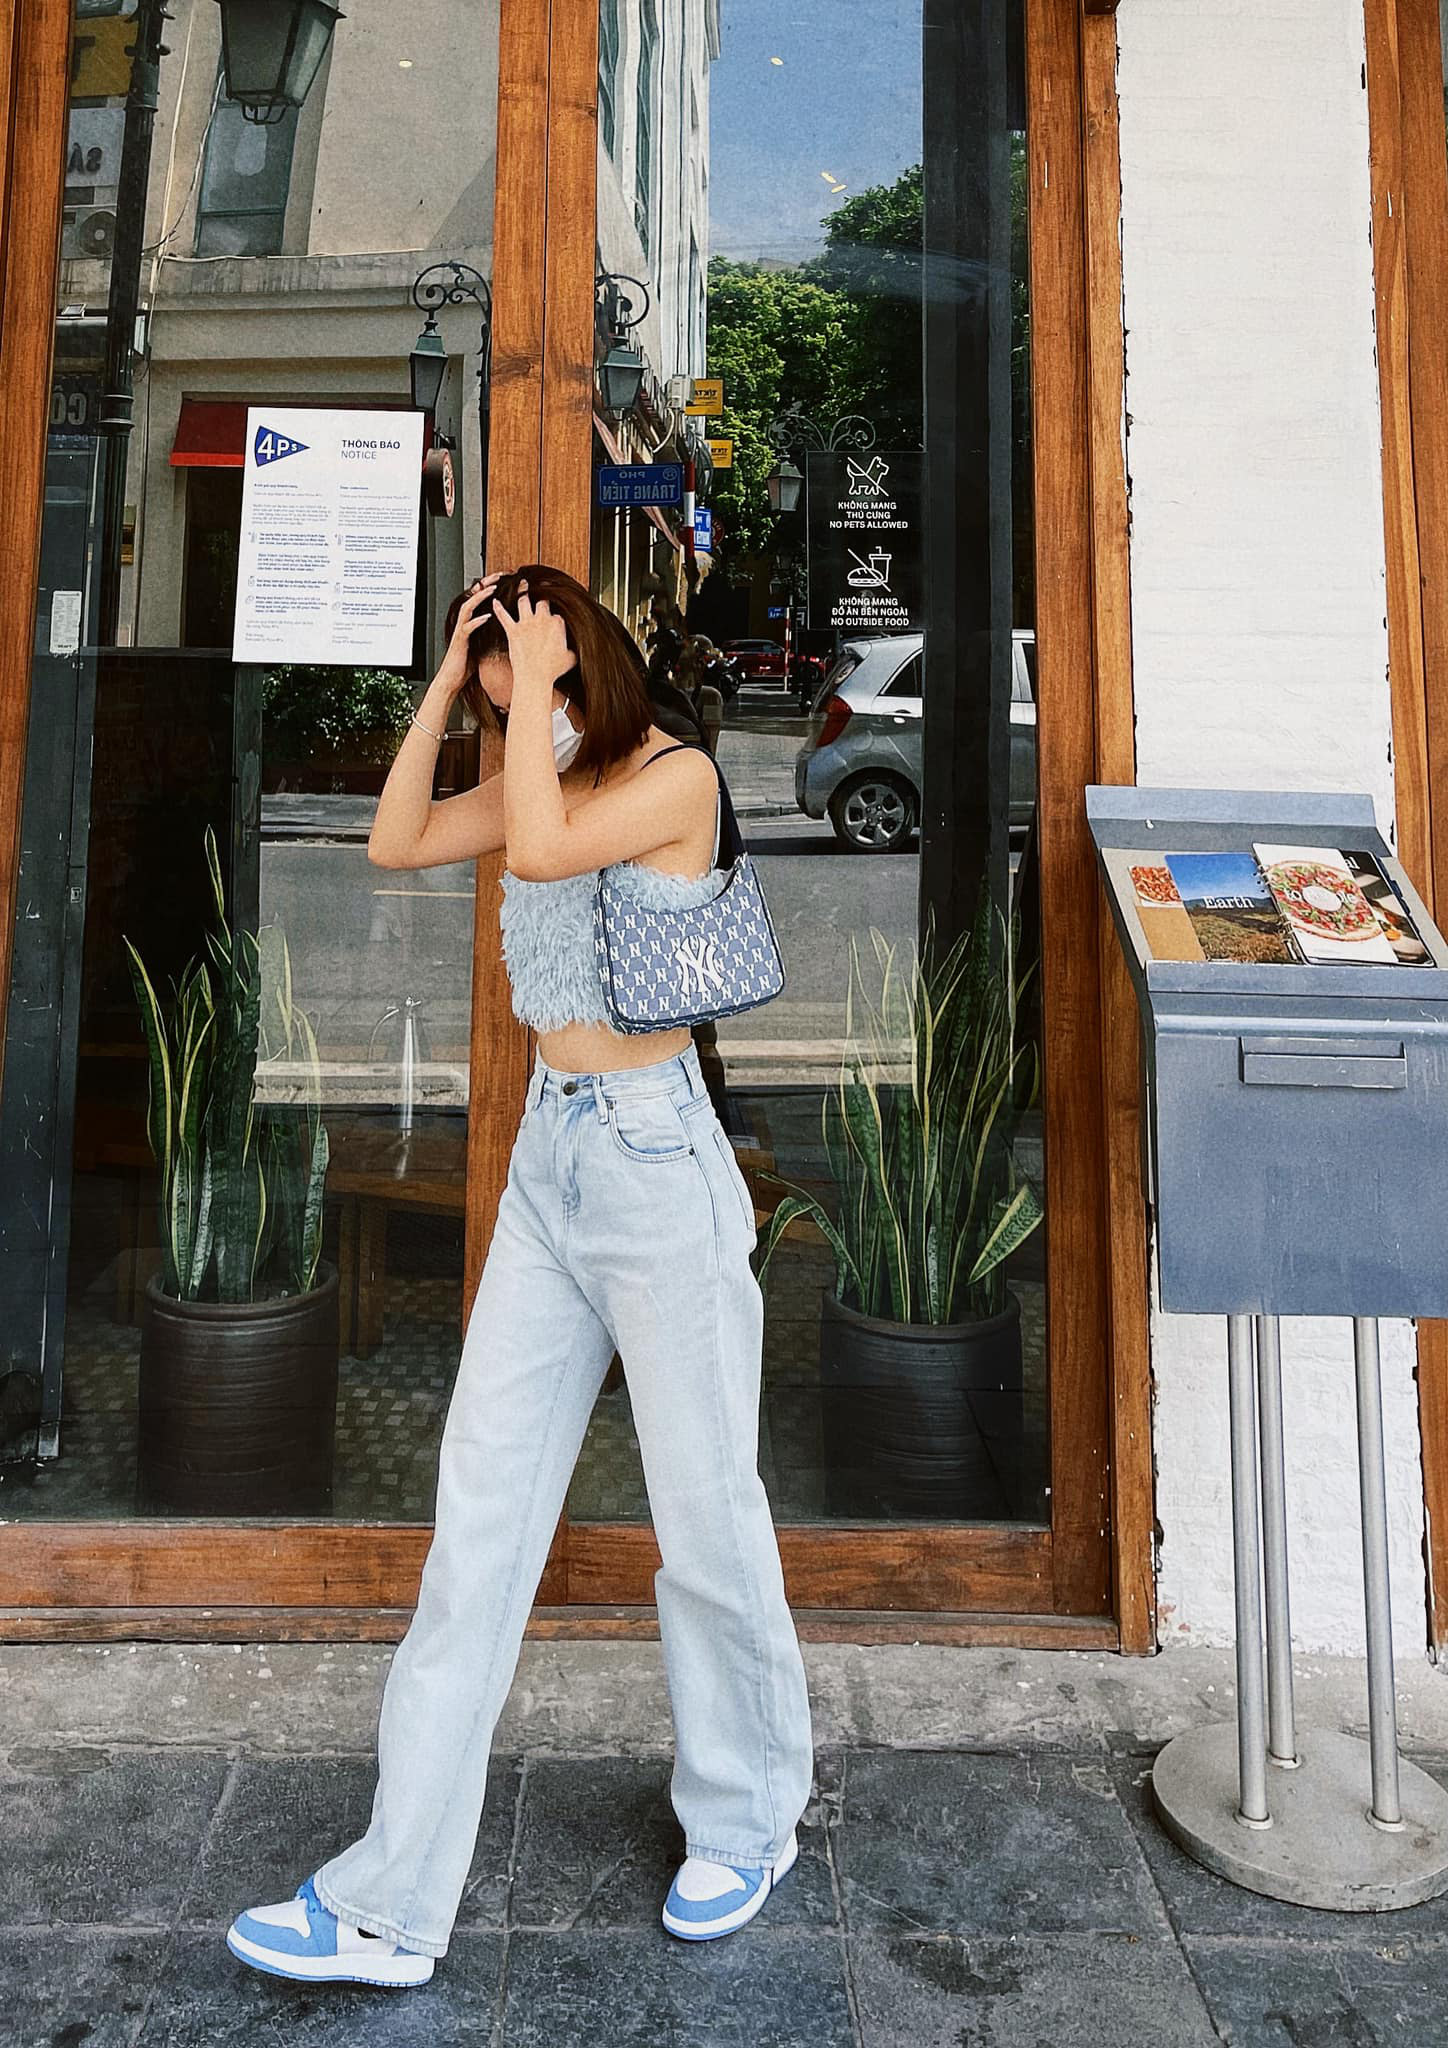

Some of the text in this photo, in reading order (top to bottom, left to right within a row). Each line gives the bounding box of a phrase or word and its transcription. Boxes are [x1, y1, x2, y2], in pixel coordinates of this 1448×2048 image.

[341, 438, 378, 450] THÔNG
[341, 450, 378, 460] NOTICE
[838, 500, 897, 510] KHÔNG MANG
[829, 520, 909, 529] NO PETS ALLOWED
[839, 596, 898, 606] KHÔNG MANG
[860, 606, 878, 616] BÊN
[880, 606, 908, 616] NGOÀI
[831, 617, 910, 626] NO OUTSIDE FOOD
[1201, 895, 1255, 909] Earth
[674, 936, 725, 994] NY
